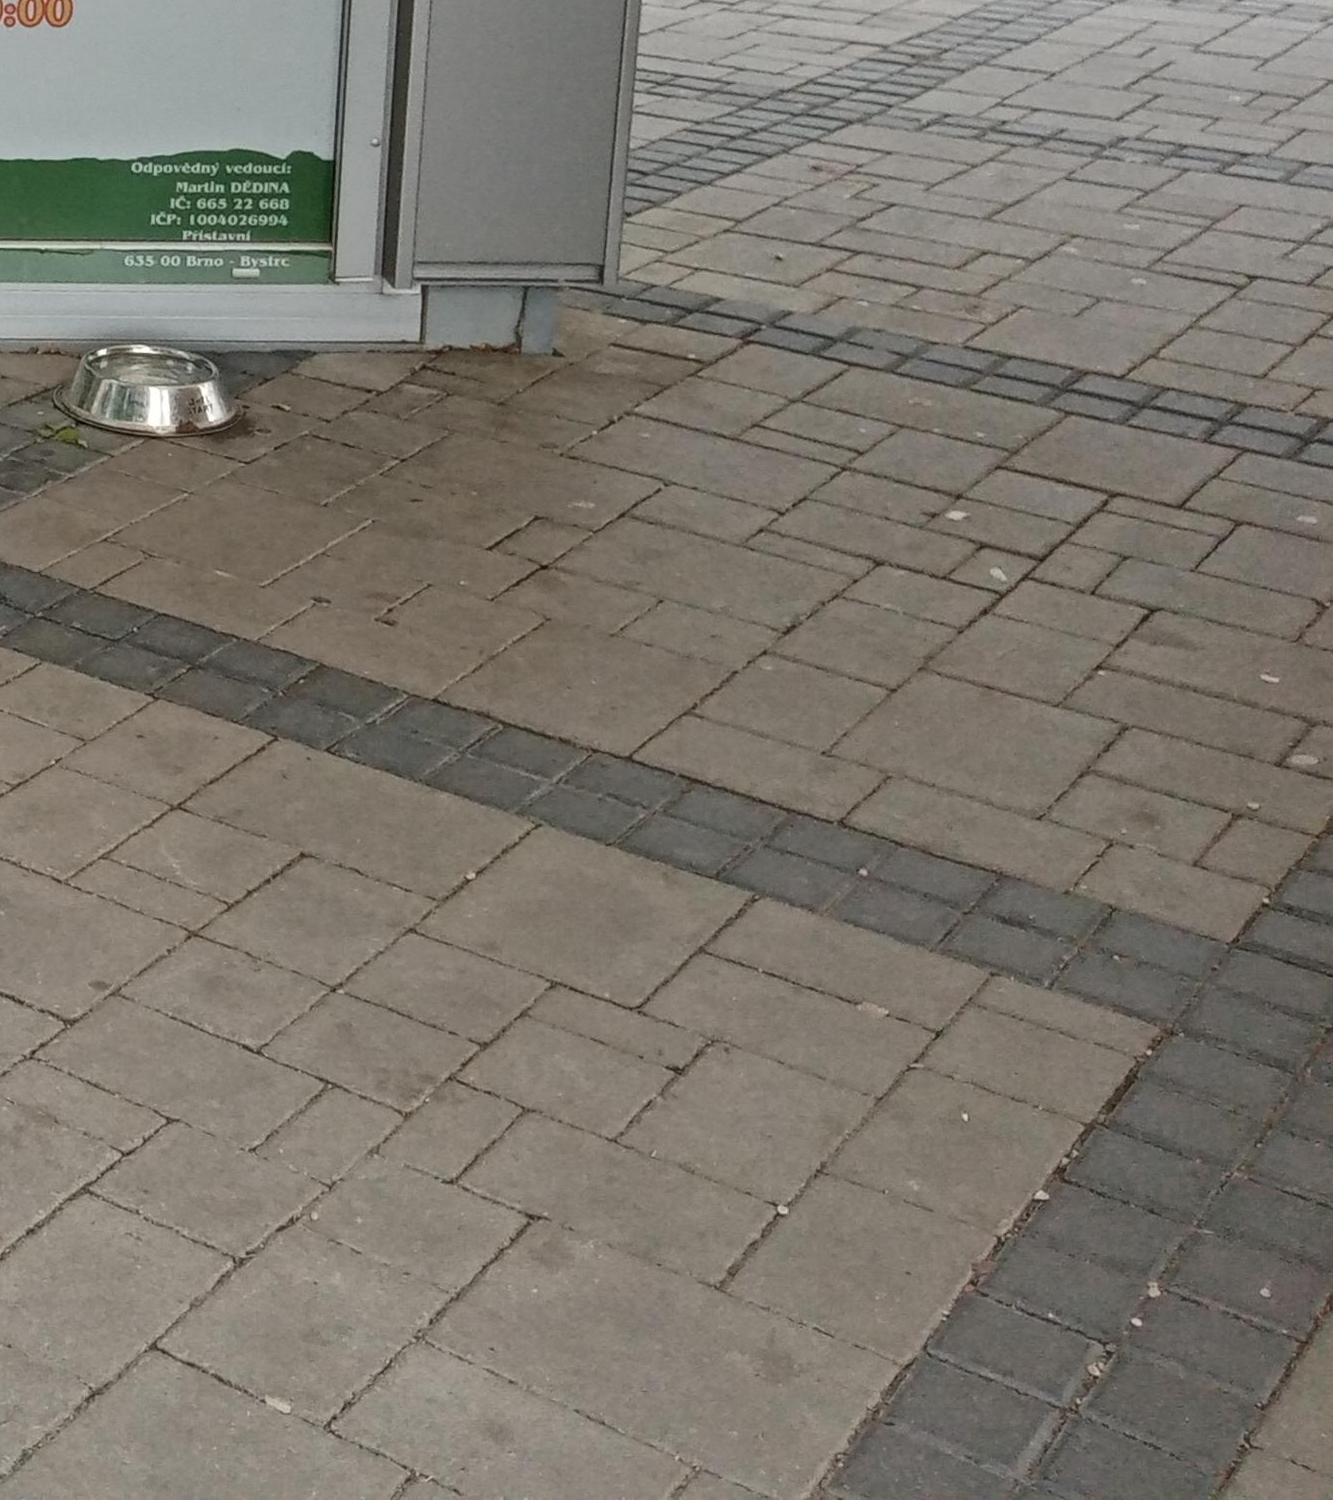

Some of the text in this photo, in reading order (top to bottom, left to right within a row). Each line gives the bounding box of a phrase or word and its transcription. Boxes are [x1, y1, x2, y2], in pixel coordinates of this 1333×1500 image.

[131, 161, 292, 177] Odpovědný vedoucí:
[175, 179, 291, 194] Martin DĚDINA
[169, 195, 291, 211] IČ: 665 22 668
[149, 211, 183, 226] IČP:
[182, 229, 252, 242] Přístavní
[124, 255, 155, 268] 635
[160, 255, 182, 268] 00
[186, 255, 225, 268] Brno
[240, 254, 291, 269] Bystrc
